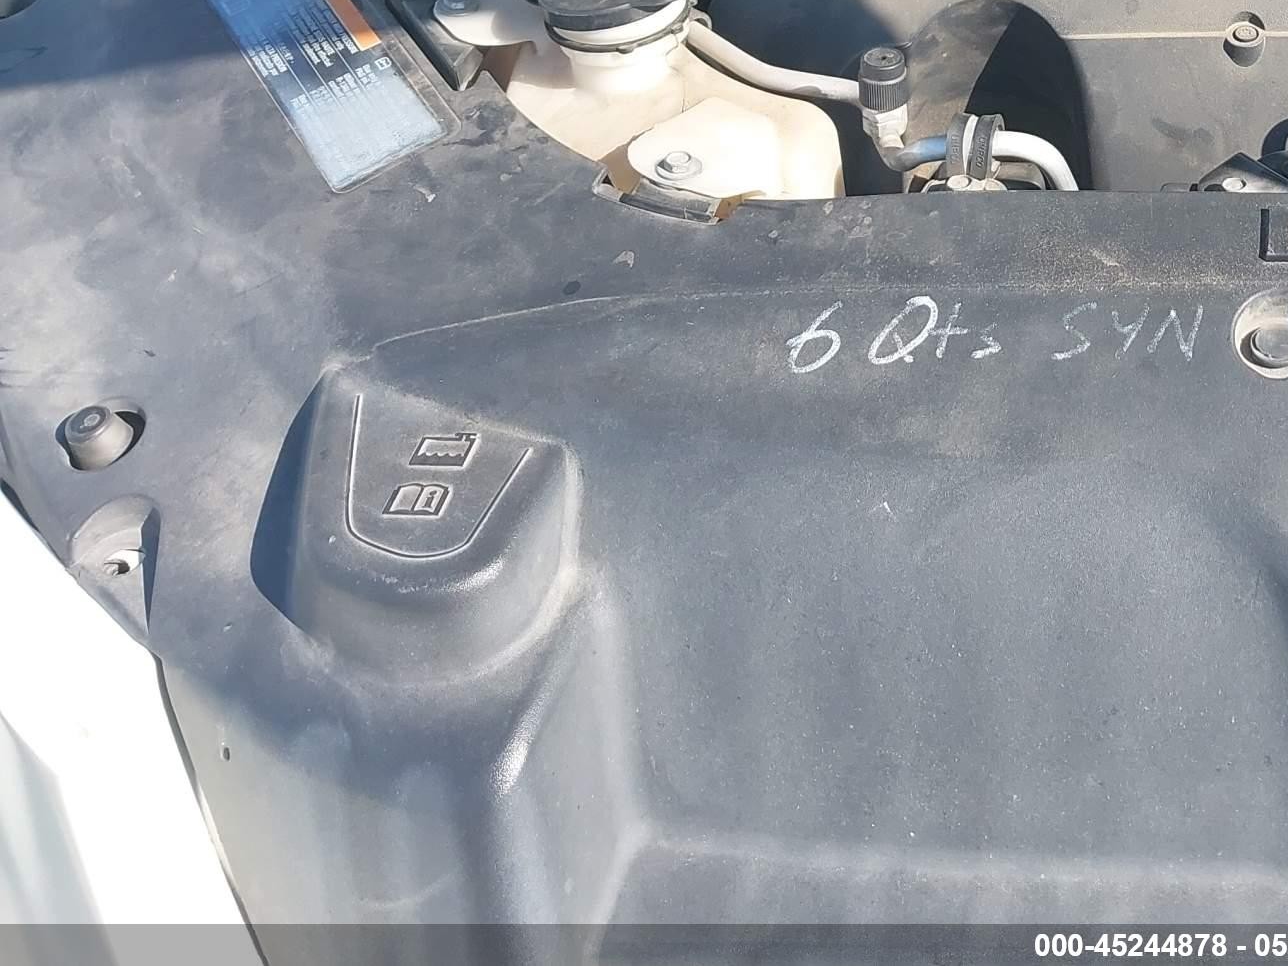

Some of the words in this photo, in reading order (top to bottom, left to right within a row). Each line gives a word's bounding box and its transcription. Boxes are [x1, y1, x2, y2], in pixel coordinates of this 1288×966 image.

[786, 300, 842, 373] 6
[867, 295, 1002, 365] Qts
[1051, 301, 1204, 362] SYN
